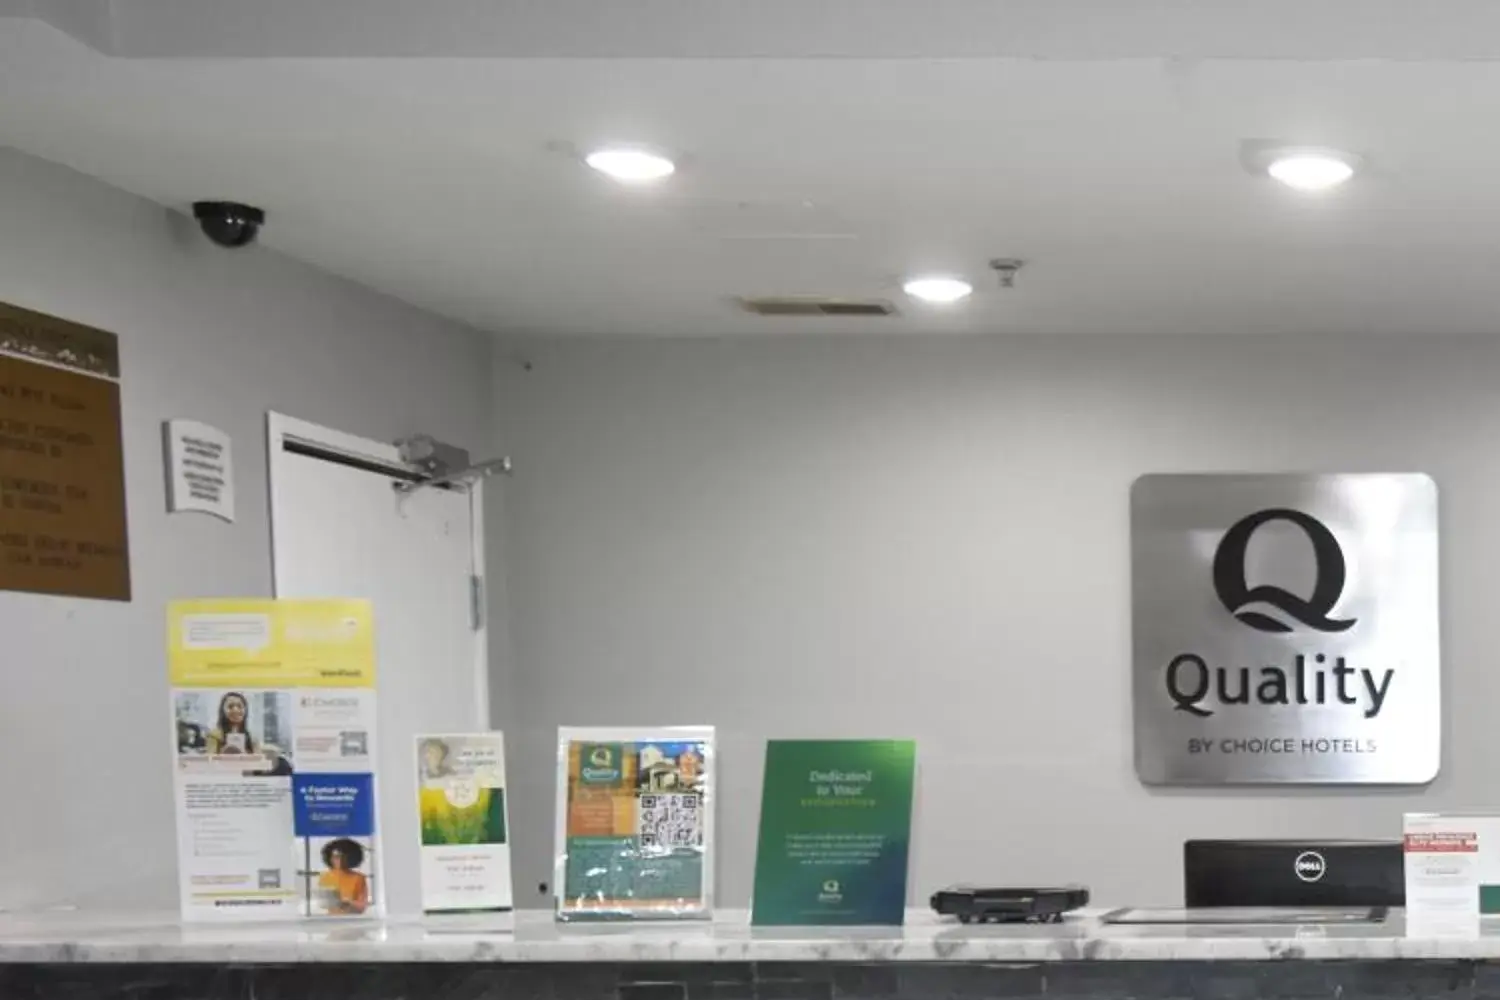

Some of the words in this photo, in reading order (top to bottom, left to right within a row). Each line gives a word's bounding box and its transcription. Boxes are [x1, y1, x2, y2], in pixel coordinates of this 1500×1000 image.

[1213, 508, 1358, 632] Q
[1166, 653, 1395, 718] Quality
[1187, 738, 1214, 754] BY
[1219, 738, 1296, 754] CHOICE
[1301, 738, 1378, 754] HOTELS
[1299, 861, 1321, 871] DELL
